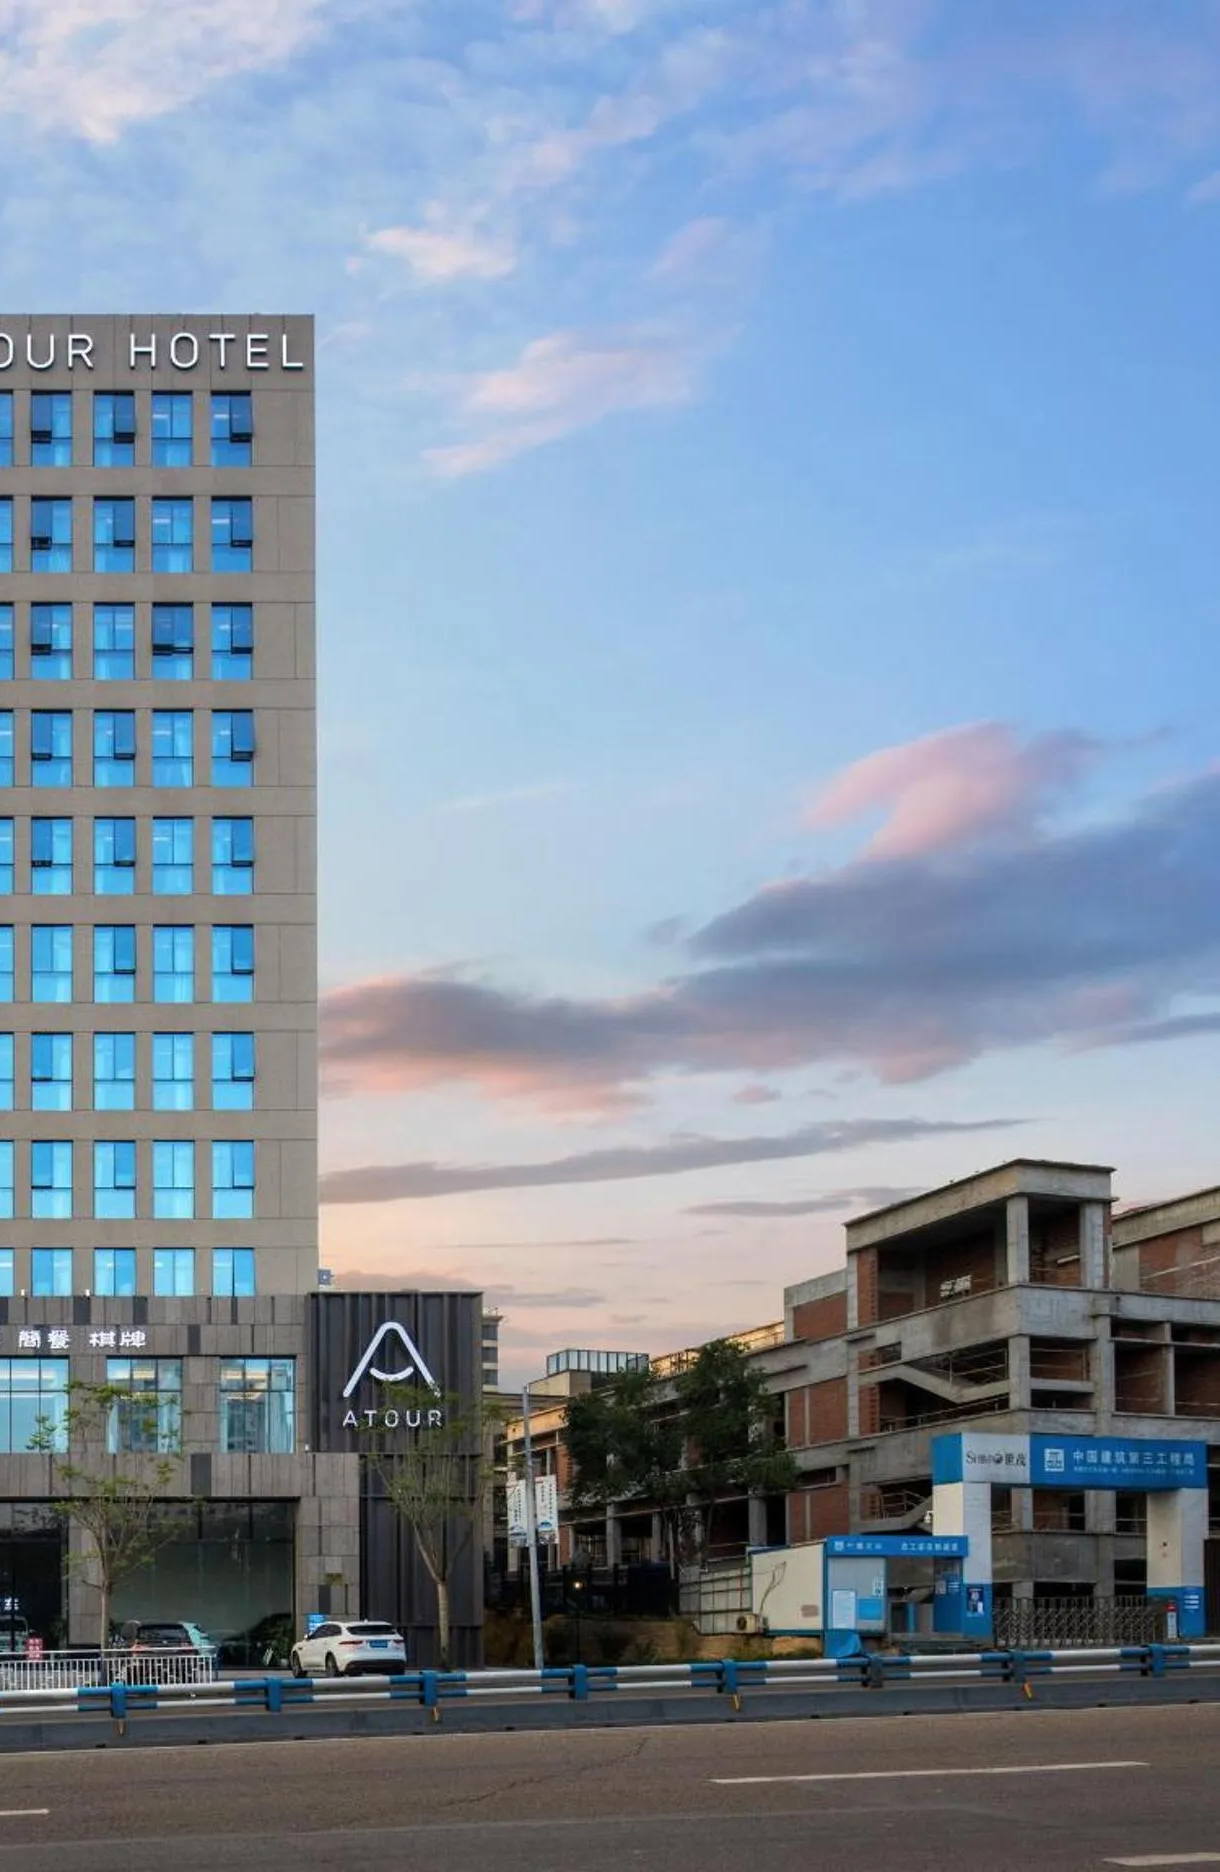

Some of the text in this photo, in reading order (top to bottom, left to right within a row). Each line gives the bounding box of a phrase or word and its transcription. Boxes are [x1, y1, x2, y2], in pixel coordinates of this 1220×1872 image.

[129, 333, 304, 369] HOTEL
[88, 1331, 147, 1348] 棋牌
[342, 1409, 443, 1427] ATOUR
